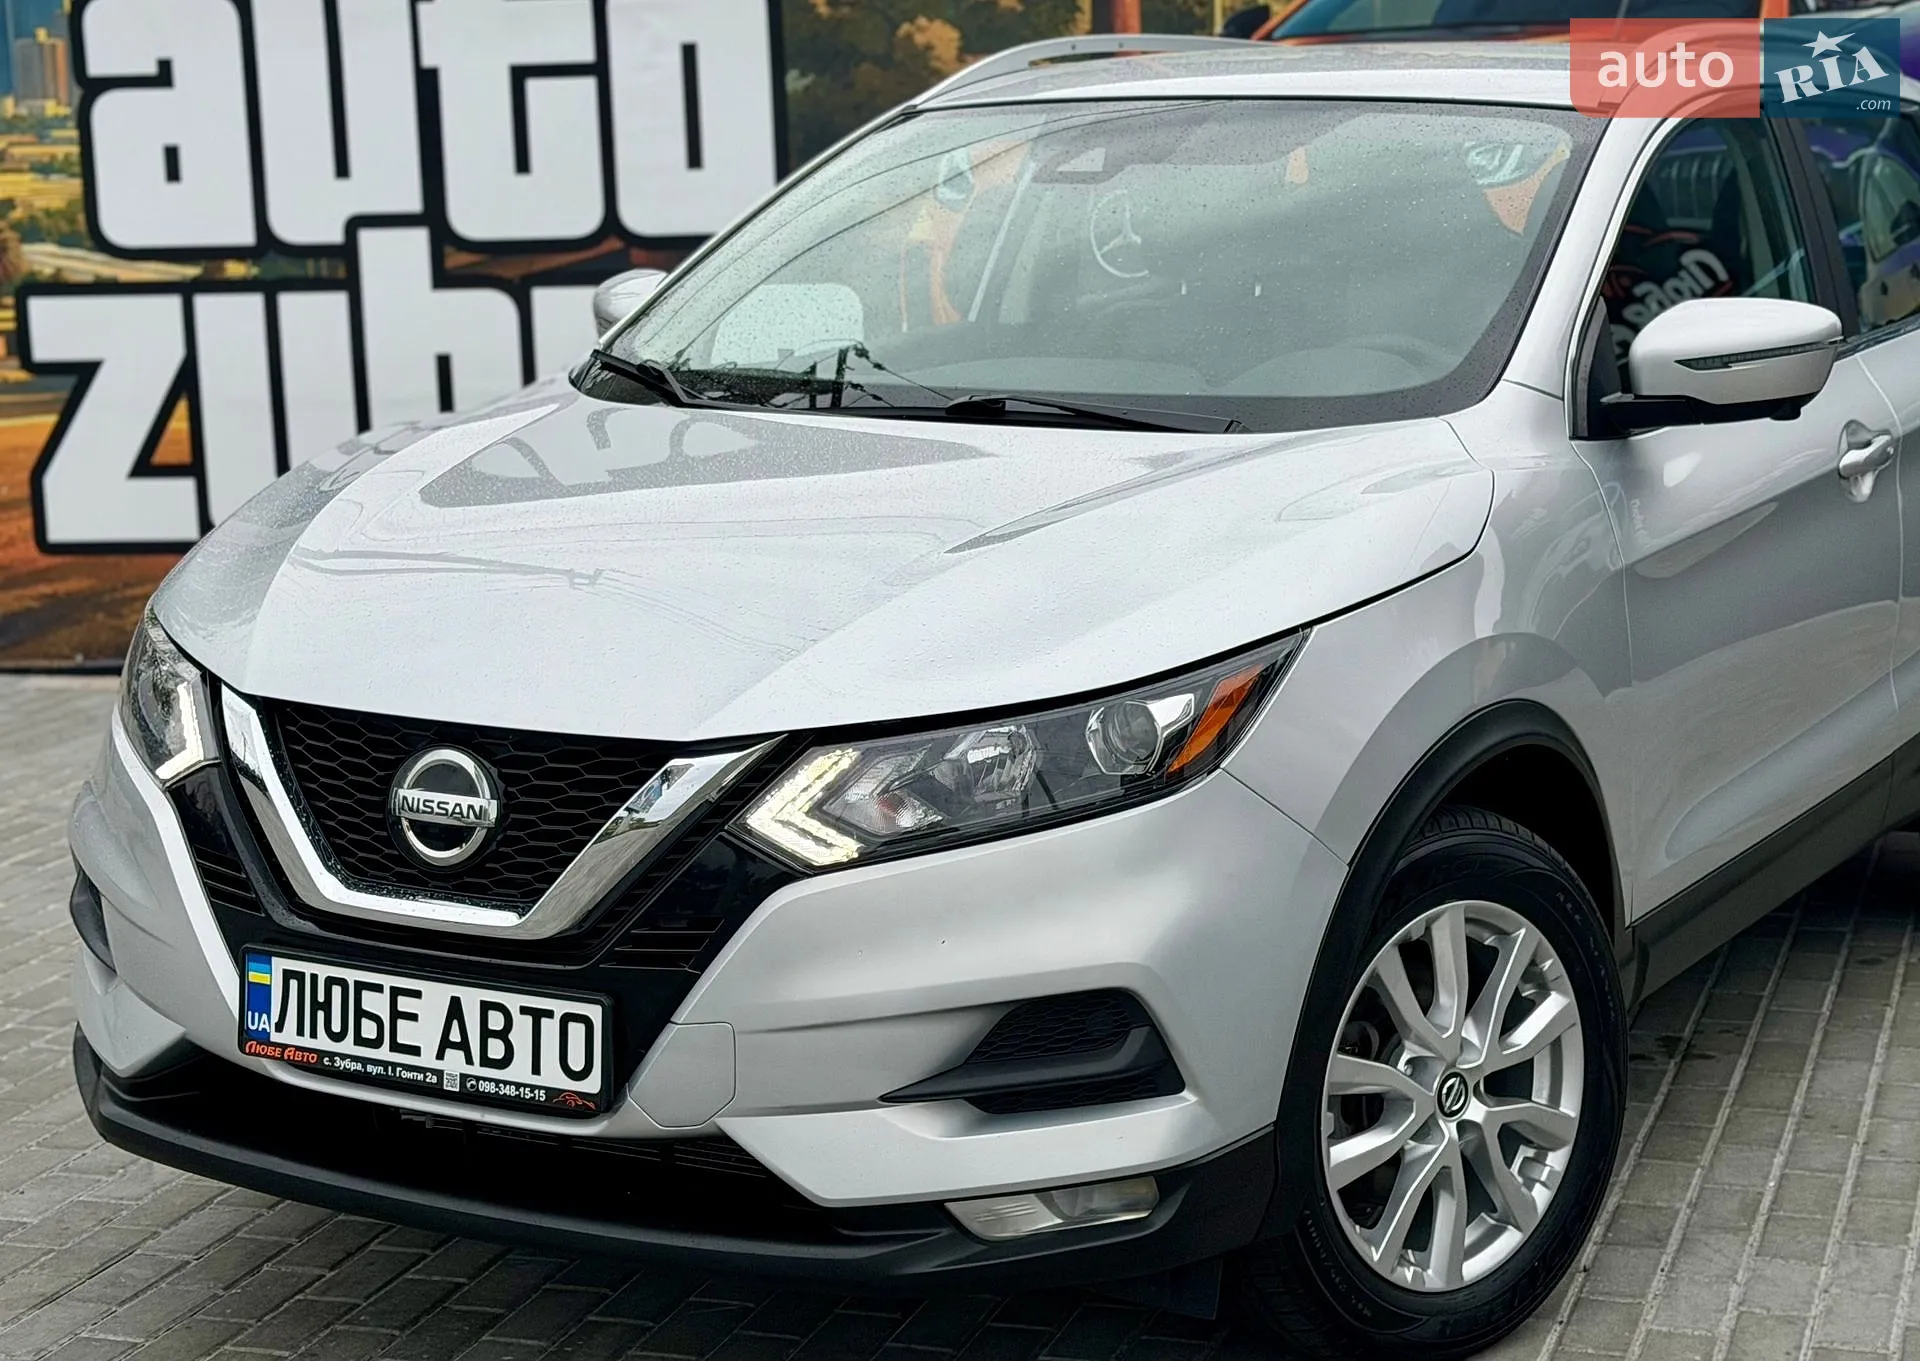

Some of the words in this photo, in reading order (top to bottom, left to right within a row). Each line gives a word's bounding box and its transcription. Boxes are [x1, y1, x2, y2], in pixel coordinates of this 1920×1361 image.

[400, 795, 483, 820] NISSAN
[247, 1010, 270, 1032] UA
[275, 967, 423, 1057] ЛЮБЕ
[435, 995, 595, 1082] АВТО
[323, 1057, 332, 1066] с.
[333, 1056, 364, 1072] Зубра,
[366, 1064, 386, 1076] вул.
[396, 1067, 424, 1081] Гонти
[478, 1080, 546, 1101] 098-348-15-15
